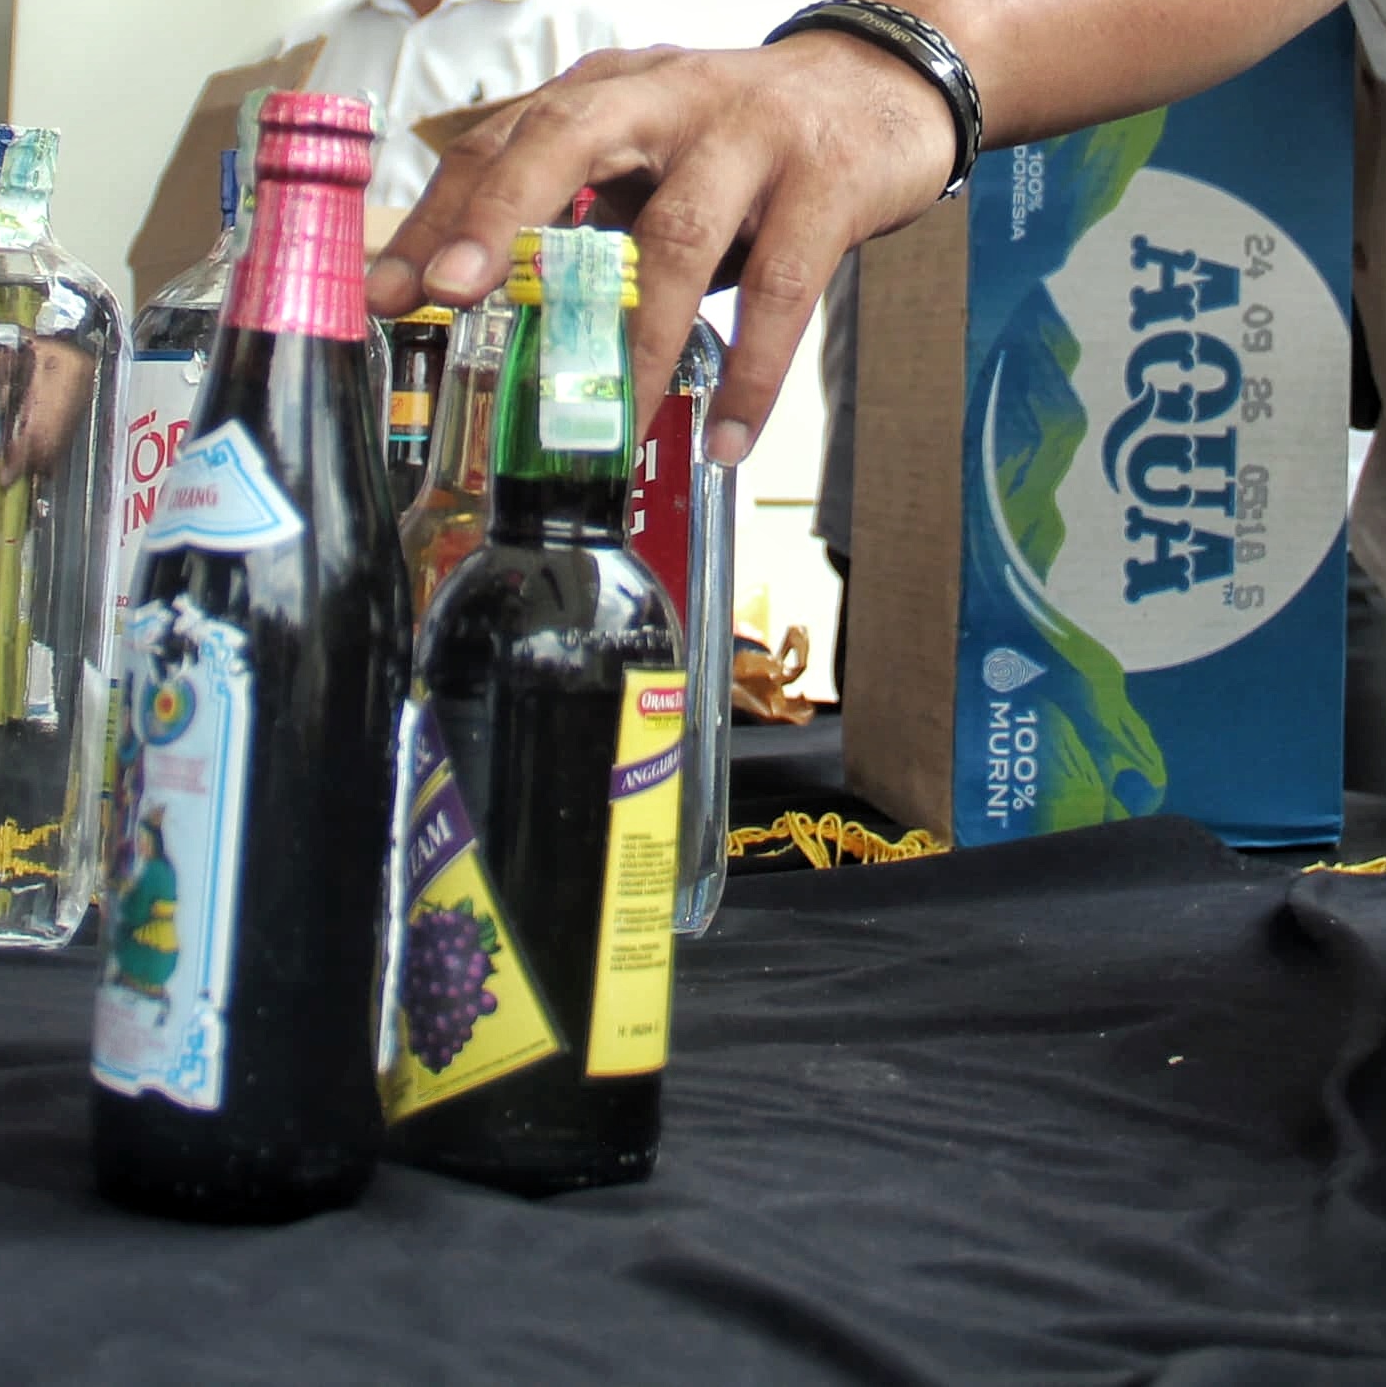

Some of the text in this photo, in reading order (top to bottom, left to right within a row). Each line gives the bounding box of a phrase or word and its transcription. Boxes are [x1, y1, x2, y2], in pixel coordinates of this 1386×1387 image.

[860, 11, 912, 44] Prodigo
[1026, 150, 1045, 213] 100%
[1244, 233, 1276, 280] 24
[1242, 303, 1274, 354] 09
[1102, 233, 1242, 605] AQUA
[985, 701, 1012, 818] MURNI
[1012, 709, 1039, 812] 100%
